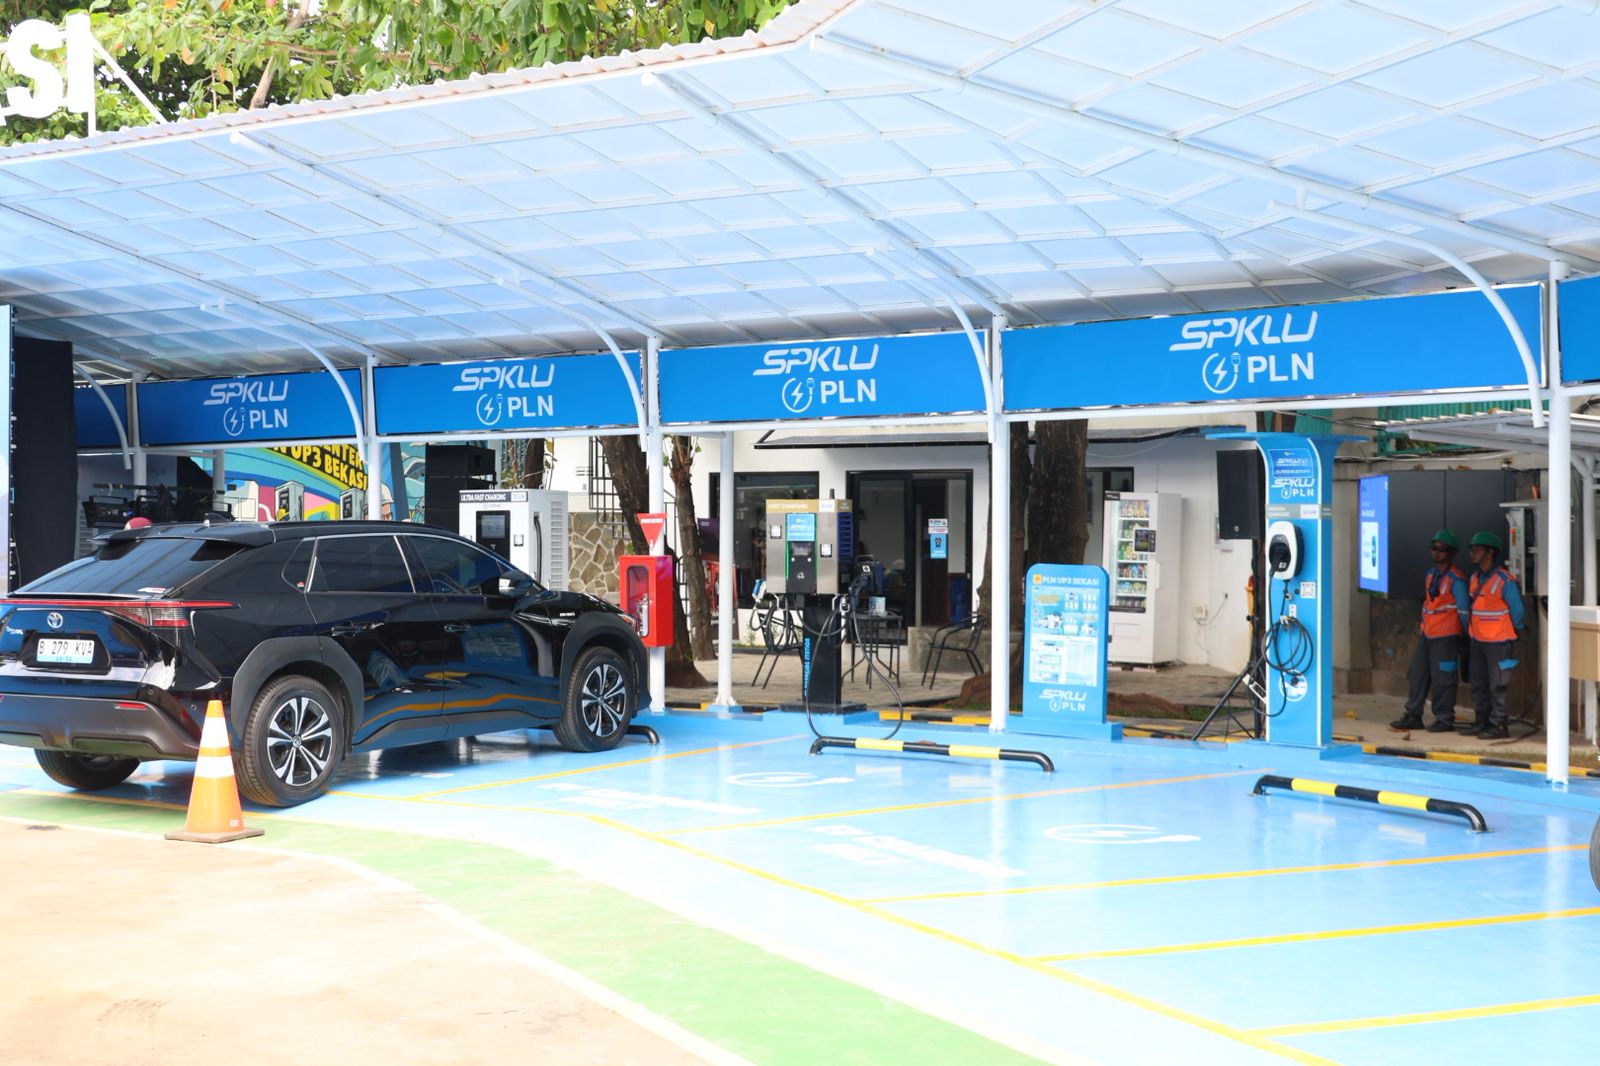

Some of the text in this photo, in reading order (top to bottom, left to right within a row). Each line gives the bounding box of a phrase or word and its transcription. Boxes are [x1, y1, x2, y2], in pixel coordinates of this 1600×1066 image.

[1169, 310, 1318, 352] SPKLU
[752, 343, 879, 376] SPKLU
[1247, 352, 1315, 383] PLN
[452, 363, 555, 392] SPKLU
[203, 380, 289, 406] SPKLU
[820, 378, 877, 404] PLN
[507, 395, 554, 418] PLN
[249, 408, 288, 429] PLN
[324, 453, 368, 490] BEKASI
[1271, 478, 1315, 488] SPKLU
[1293, 488, 1314, 497] PLN
[1072, 577, 1099, 585] BEKASI
[39, 641, 45, 654] B
[52, 641, 69, 655] 279
[1039, 689, 1087, 701] SPKLU
[1062, 701, 1086, 712] PLN
